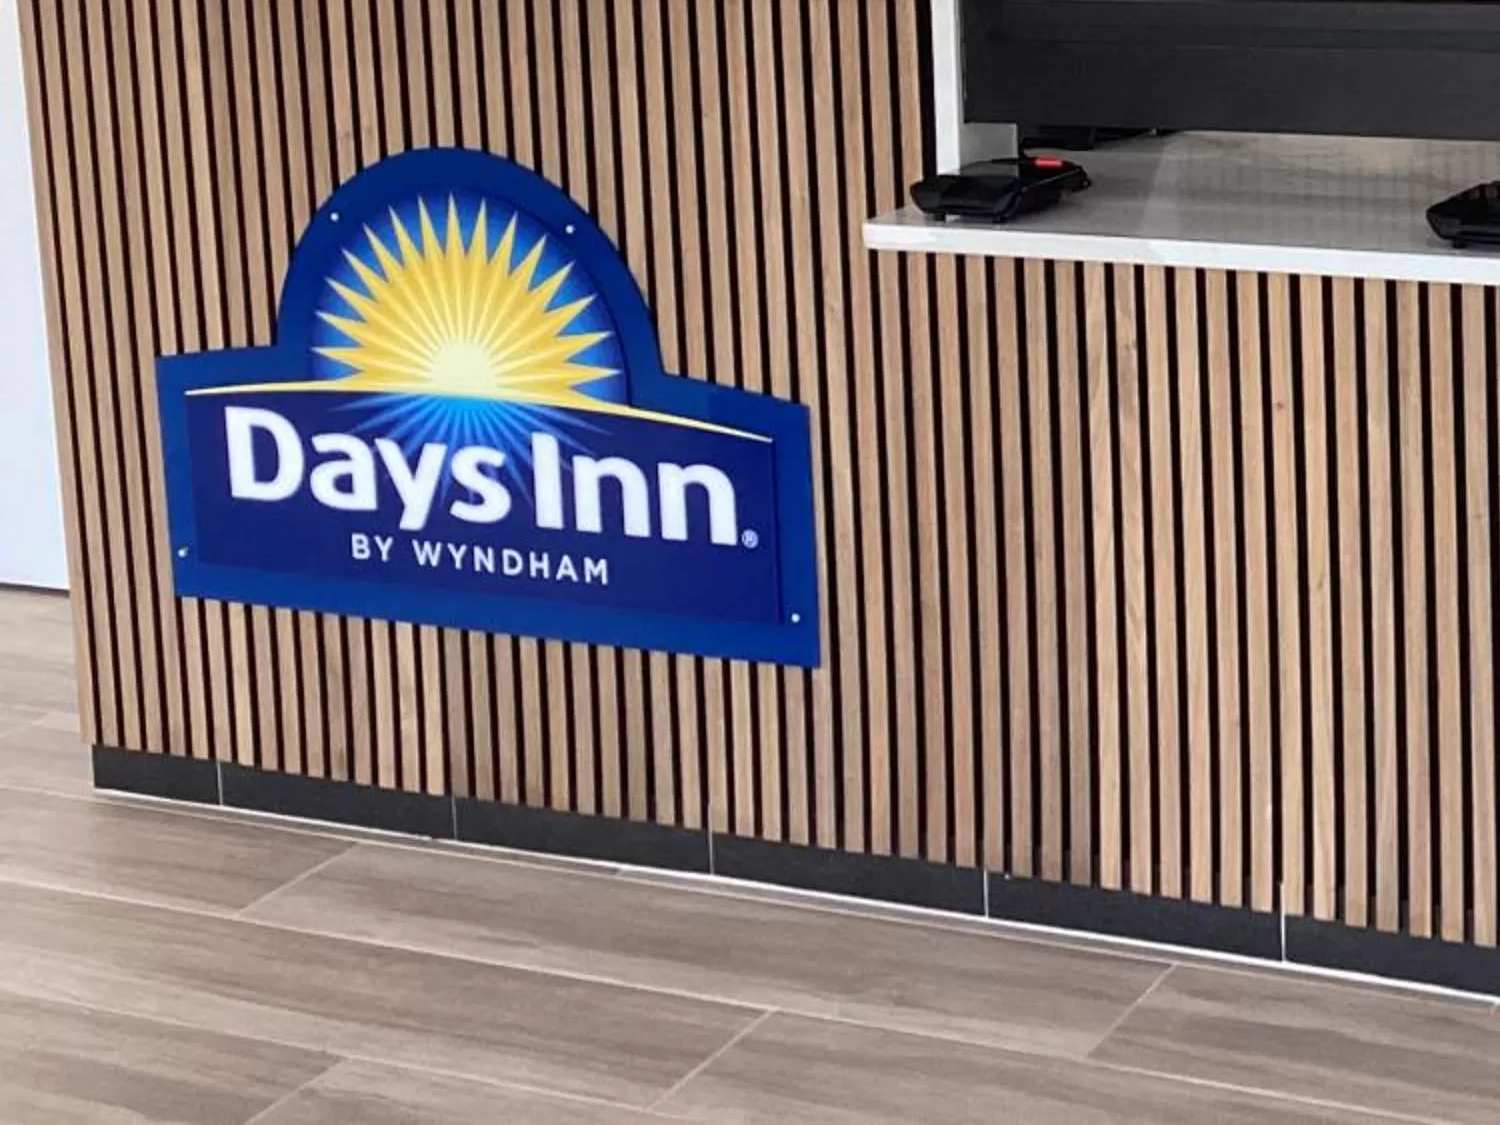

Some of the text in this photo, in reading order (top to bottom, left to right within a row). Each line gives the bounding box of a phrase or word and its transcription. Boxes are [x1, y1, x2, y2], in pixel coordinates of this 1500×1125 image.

[224, 406, 512, 531] Days
[531, 431, 738, 546] Inn
[351, 532, 609, 586] BY WYNDHAM
